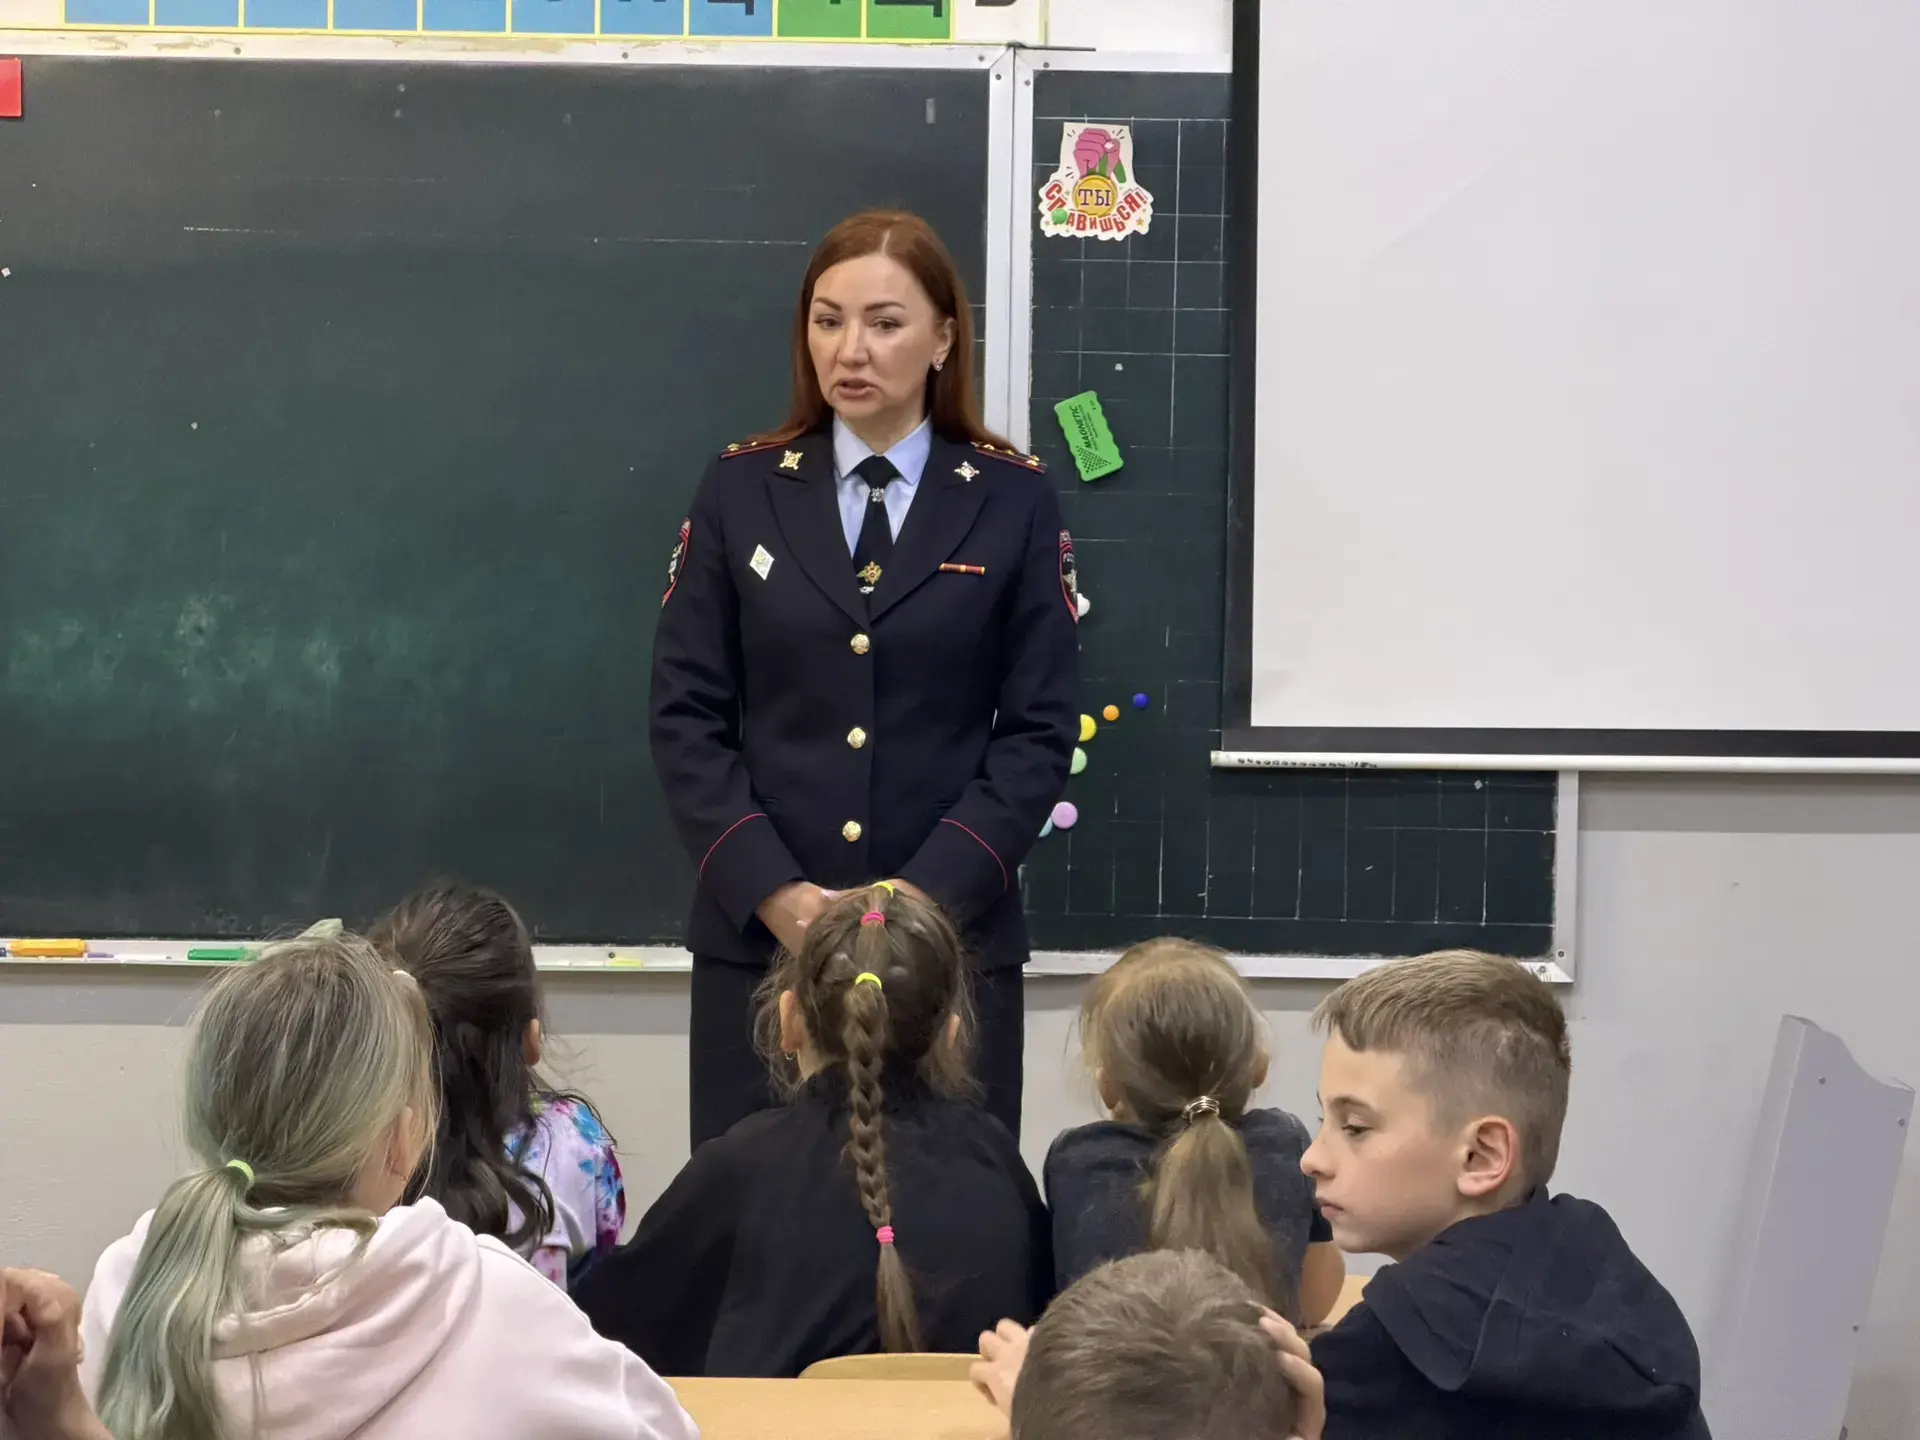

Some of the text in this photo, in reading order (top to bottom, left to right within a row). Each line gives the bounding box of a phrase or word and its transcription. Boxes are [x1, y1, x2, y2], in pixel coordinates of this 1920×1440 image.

[1045, 182, 1148, 232] СПАВИШЬСЯ!
[1078, 188, 1112, 206] ТЫ
[1069, 404, 1093, 450] MAGNETIC
